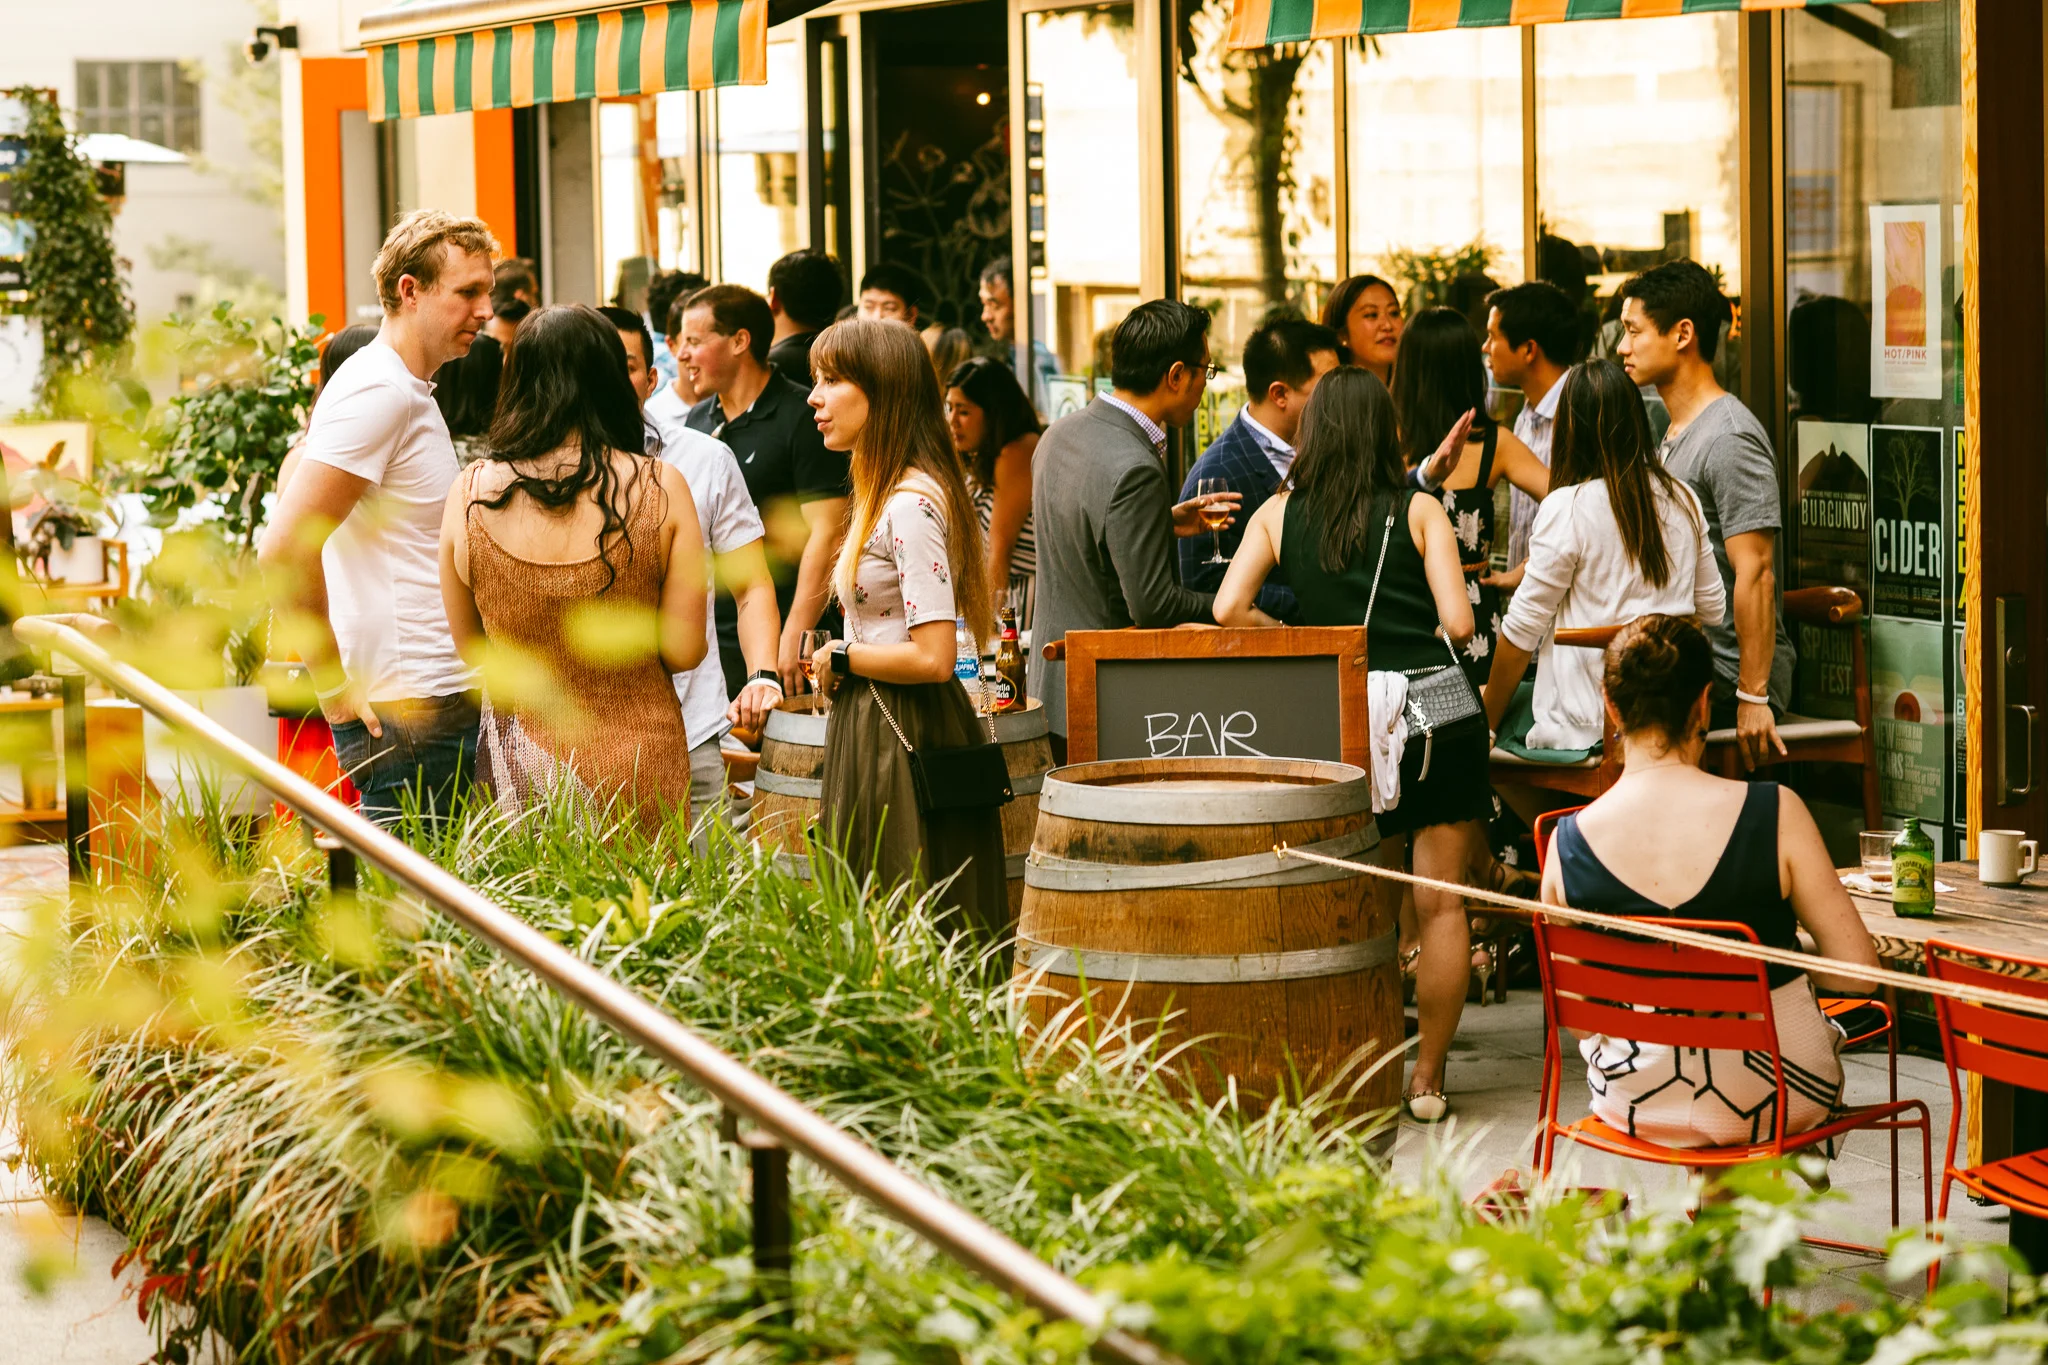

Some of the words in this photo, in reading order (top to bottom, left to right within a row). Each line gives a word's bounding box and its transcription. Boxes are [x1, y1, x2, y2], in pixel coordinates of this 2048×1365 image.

[1884, 348, 1927, 360] HOT/PINK
[1801, 497, 1867, 530] BURGUNDY
[1874, 517, 1941, 578] CIDER
[1821, 663, 1852, 695] FEST
[1144, 710, 1272, 757] BAR
